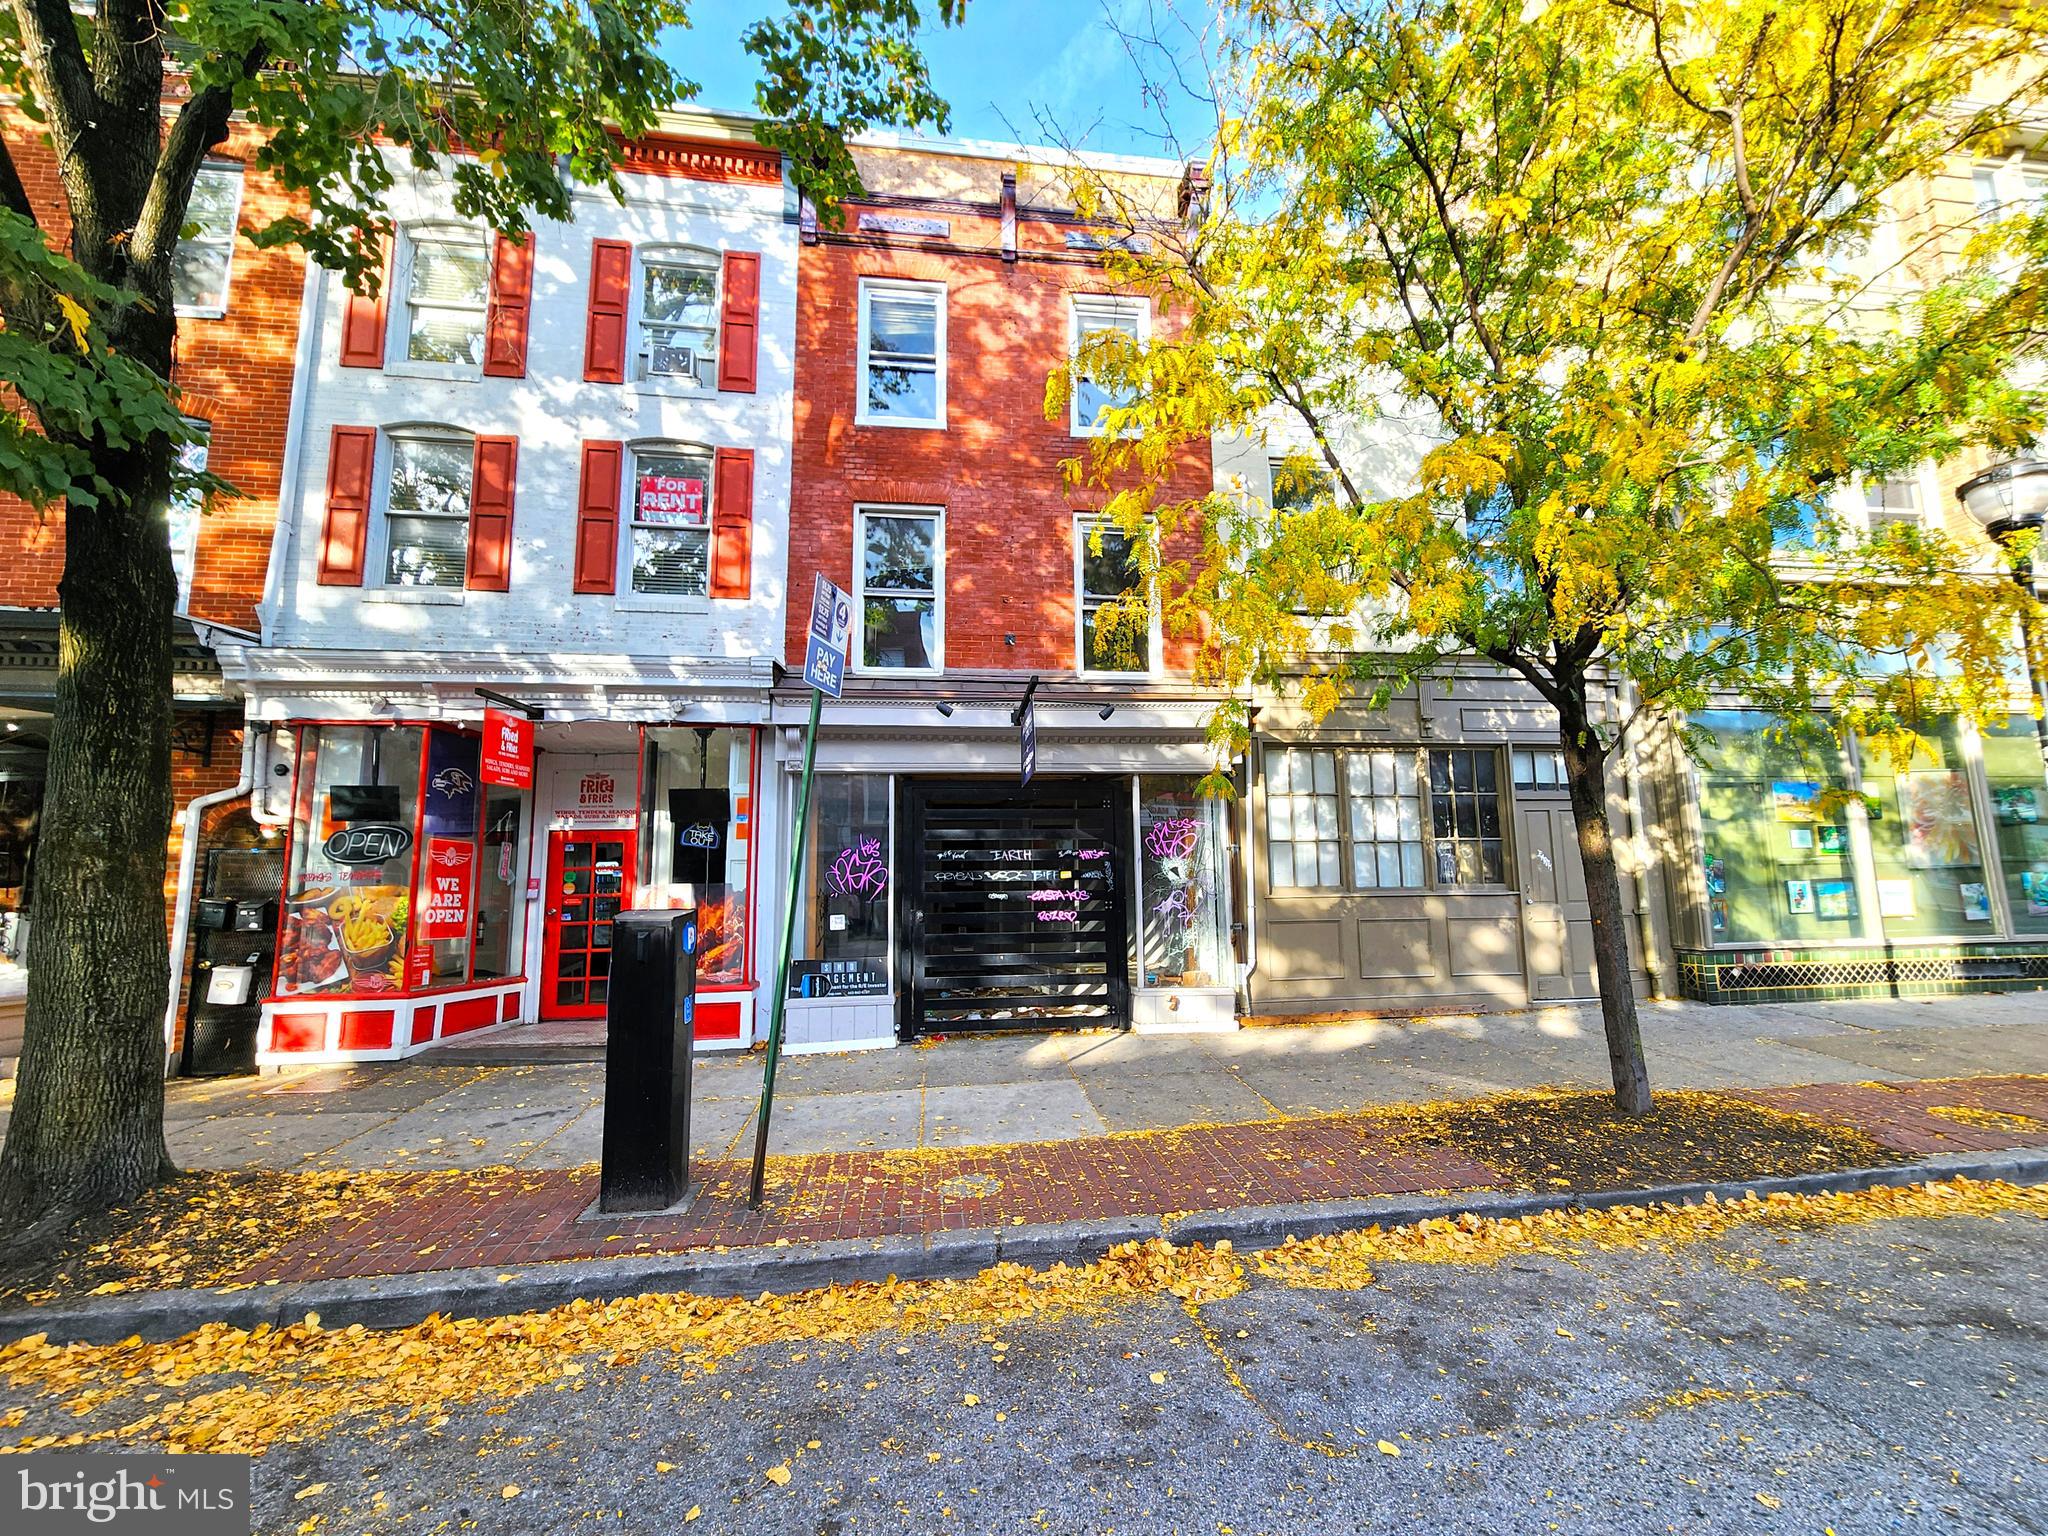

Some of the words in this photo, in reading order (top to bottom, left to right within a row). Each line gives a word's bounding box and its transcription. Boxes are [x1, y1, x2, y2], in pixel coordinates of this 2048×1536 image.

[656, 479, 688, 492] FOR
[642, 491, 702, 511] RENT
[817, 646, 836, 669] PAY
[810, 663, 838, 689] HERE
[579, 794, 587, 804] &
[689, 829, 715, 839] TAKE
[328, 832, 401, 856] OPEN
[690, 837, 714, 846] OUT
[436, 877, 459, 891] WE
[432, 893, 462, 907] ARE
[424, 909, 465, 923] OPEN
